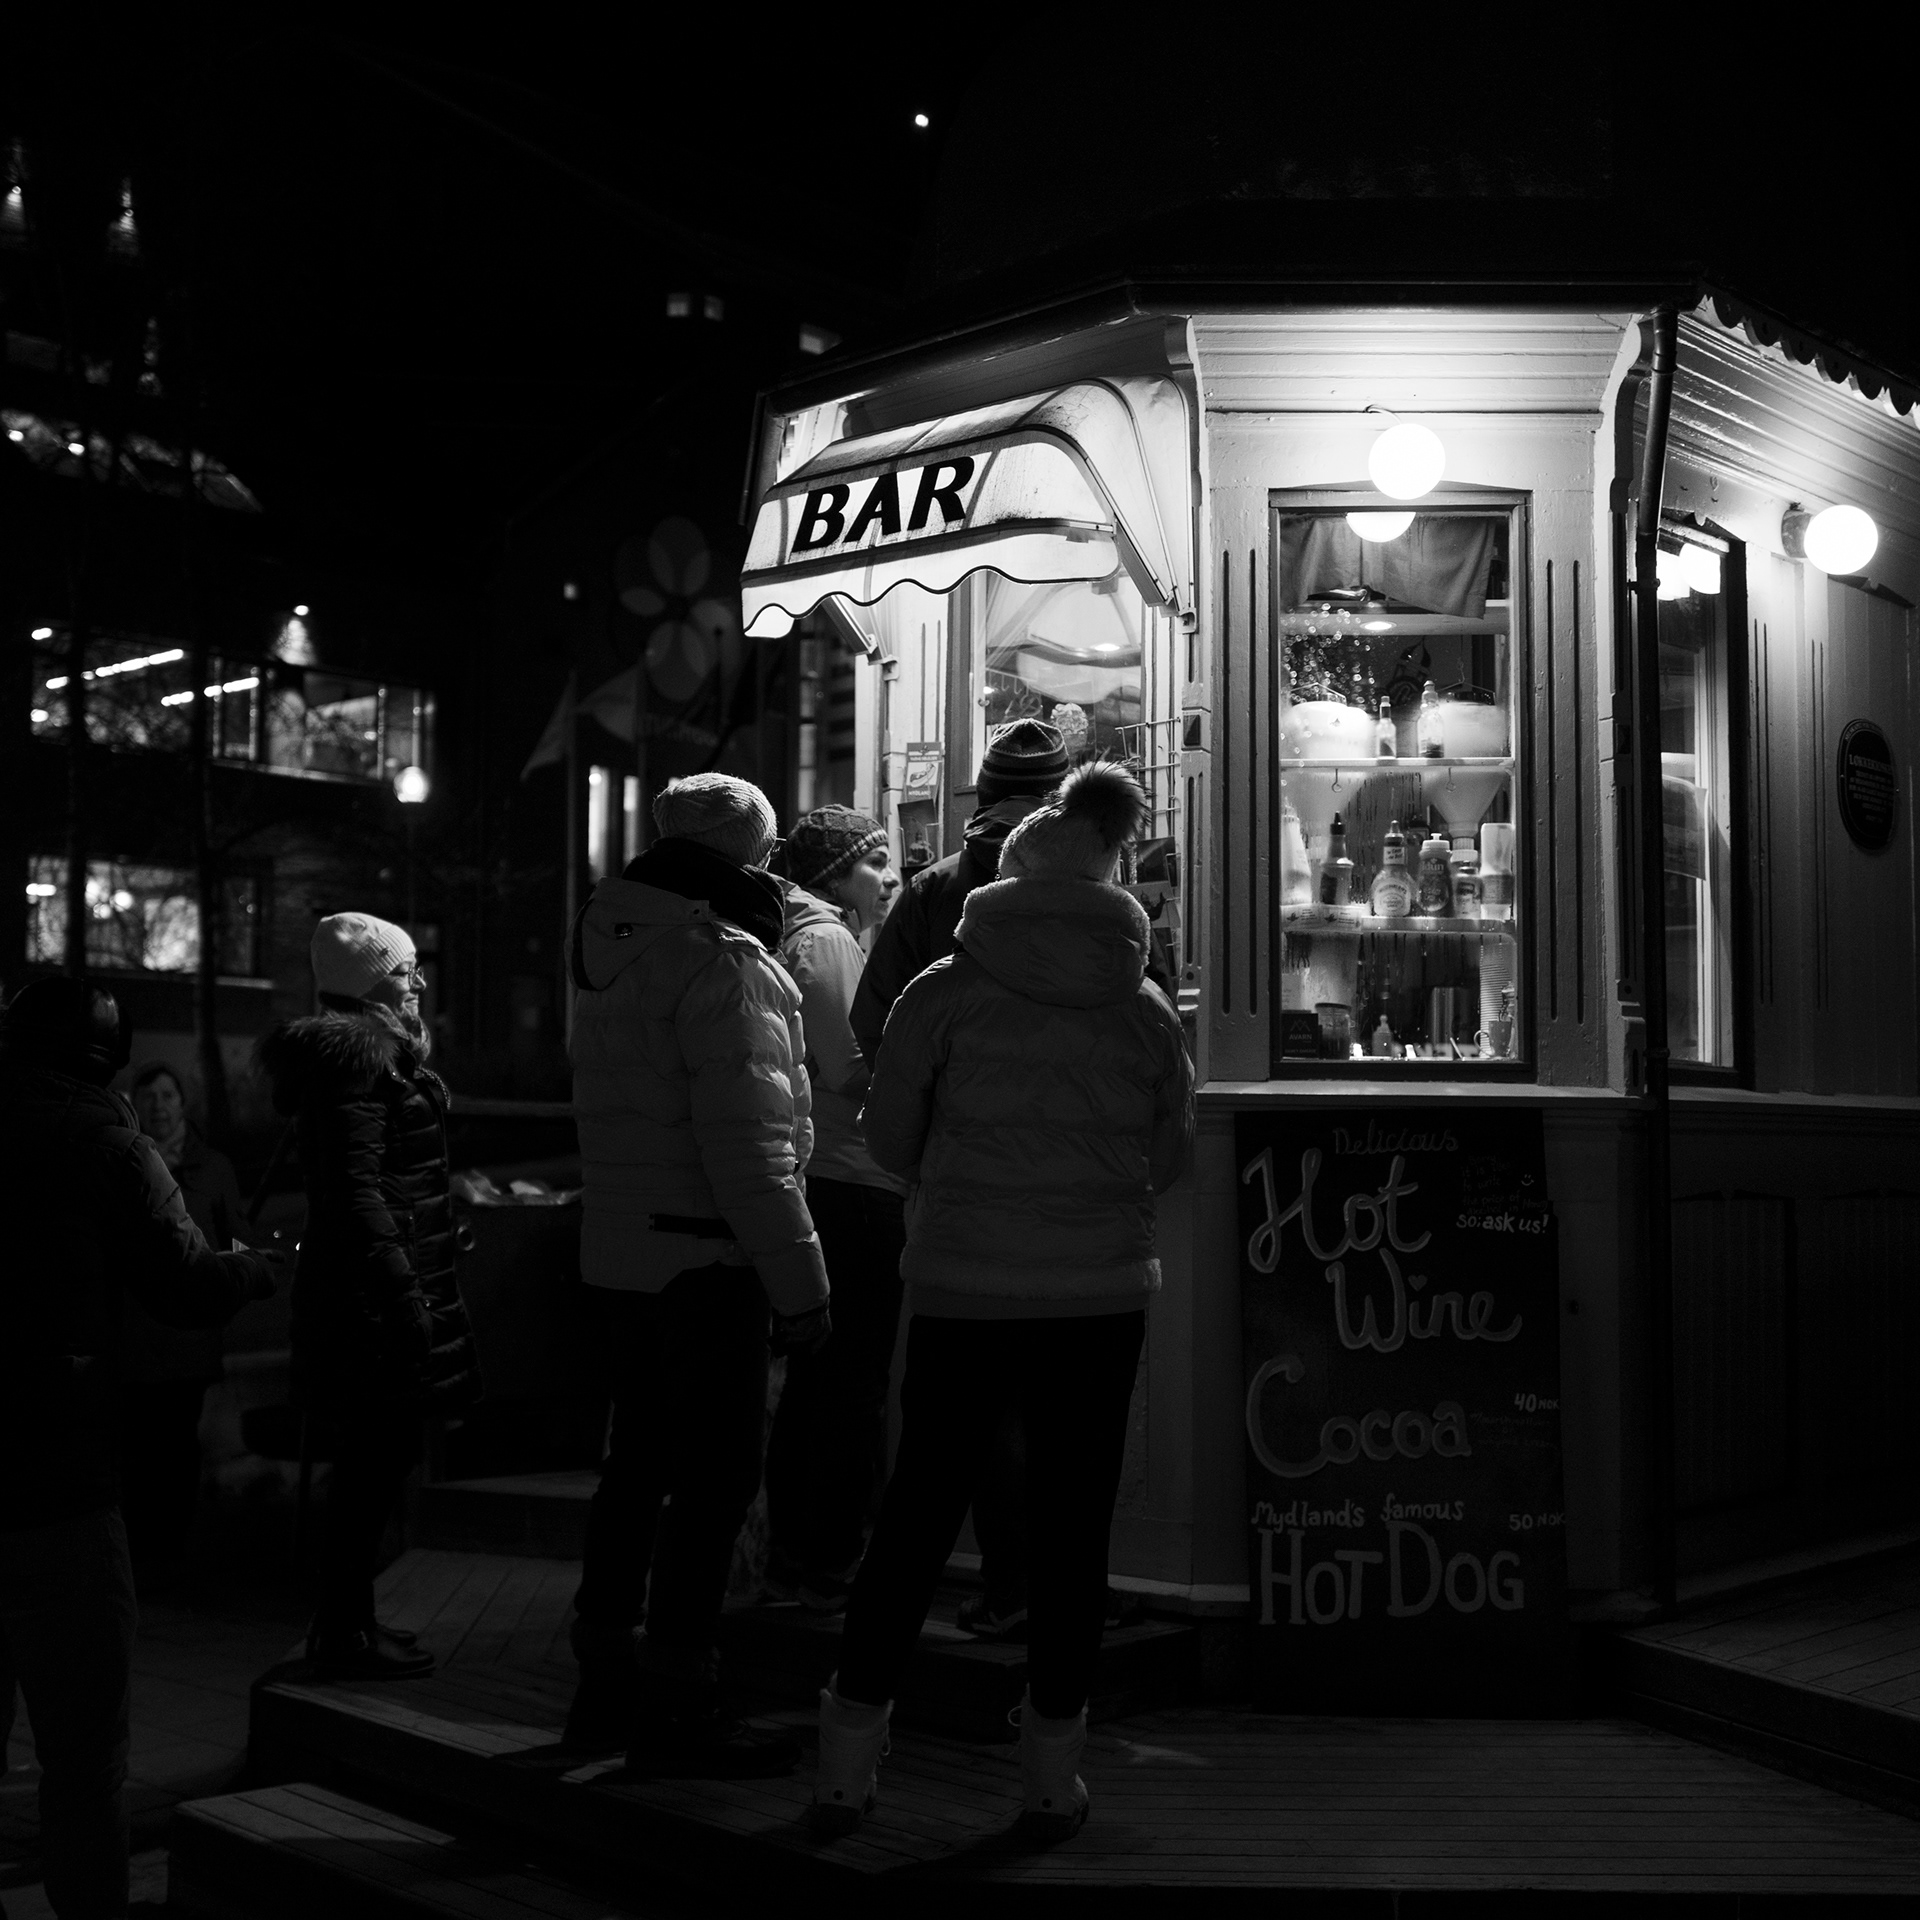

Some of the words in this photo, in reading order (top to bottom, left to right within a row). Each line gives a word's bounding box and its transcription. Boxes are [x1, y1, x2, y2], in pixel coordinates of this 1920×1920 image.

[791, 456, 975, 553] BAR
[1332, 1118, 1459, 1155] Delicious
[1242, 1146, 1432, 1274] Hot
[1518, 1213, 1550, 1235] us!
[1325, 1247, 1523, 1353] Wine
[1245, 1353, 1472, 1479] Cocoa
[1514, 1392, 1537, 1413] 40
[1250, 1499, 1365, 1534] Mydland's
[1380, 1492, 1465, 1523] famous
[1509, 1513, 1534, 1532] 50
[1537, 1511, 1566, 1528] NOK
